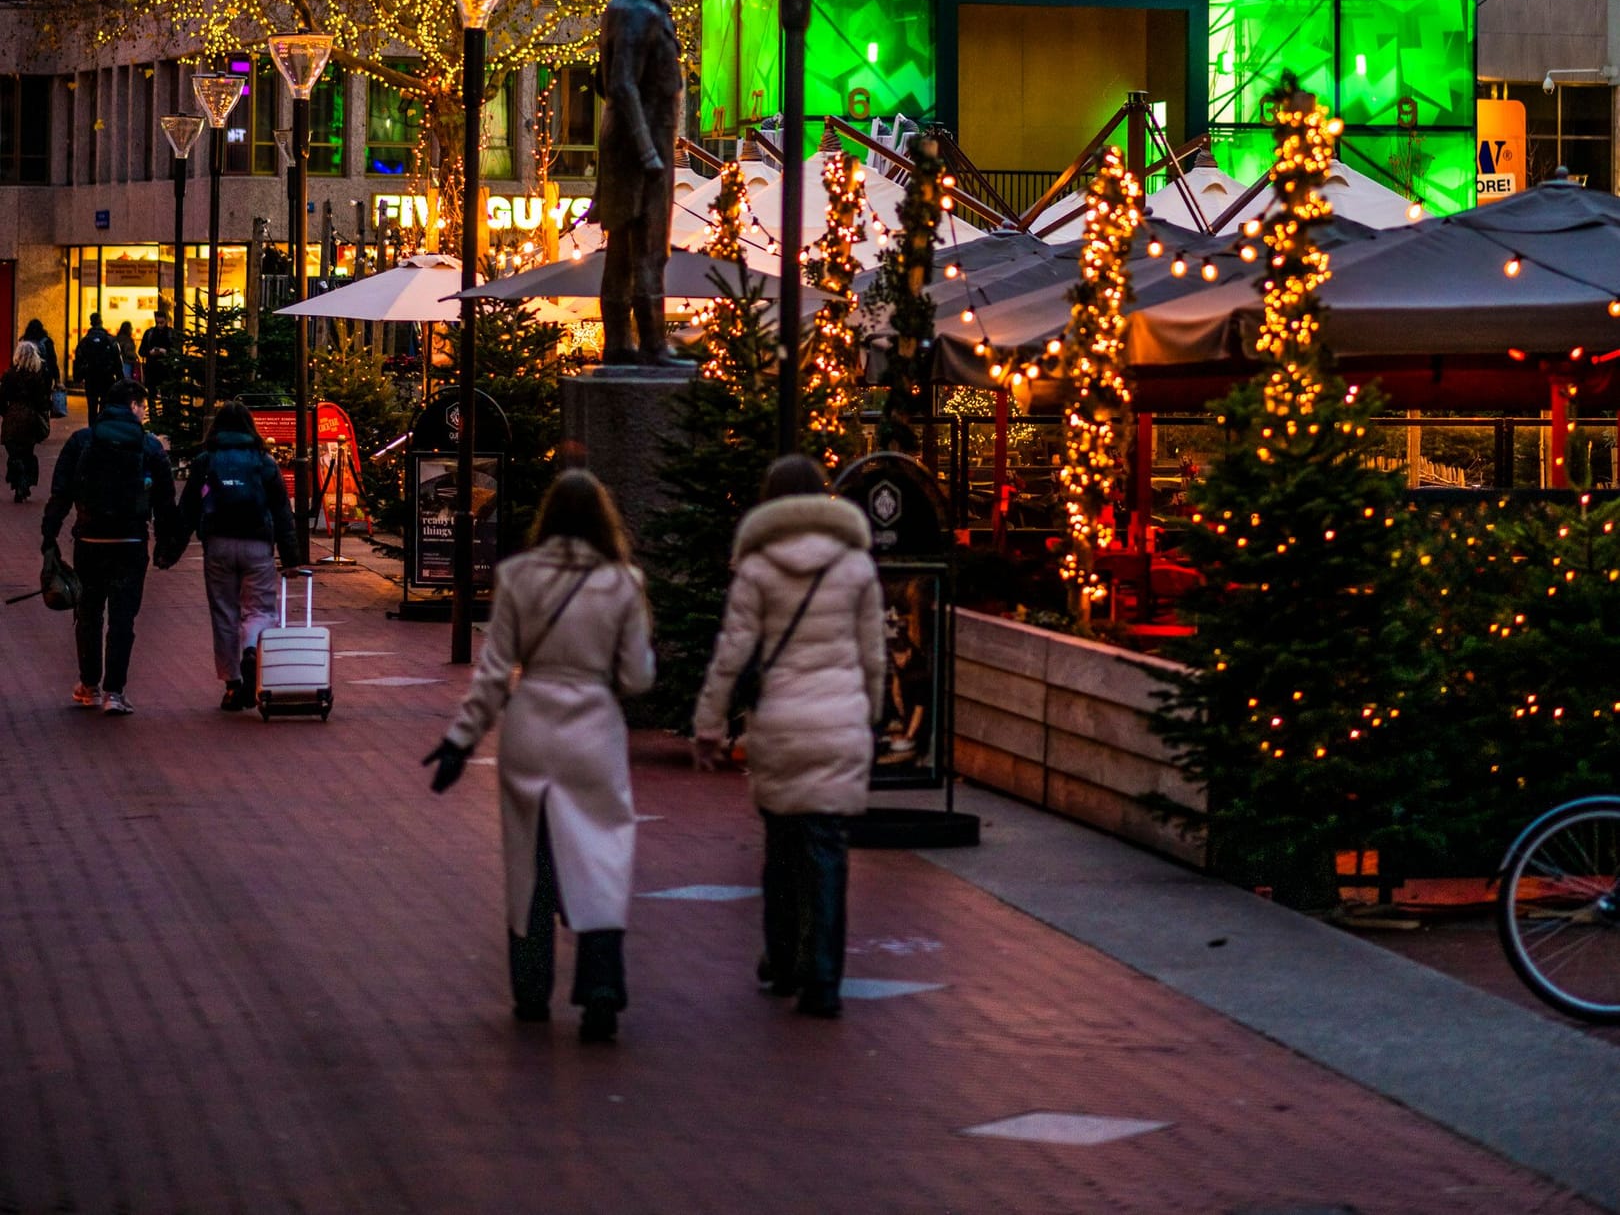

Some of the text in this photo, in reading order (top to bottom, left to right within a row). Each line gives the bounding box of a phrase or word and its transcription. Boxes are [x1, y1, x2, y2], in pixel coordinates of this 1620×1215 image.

[847, 87, 871, 120] 6
[1397, 96, 1418, 128] 9
[374, 194, 441, 228] FIV
